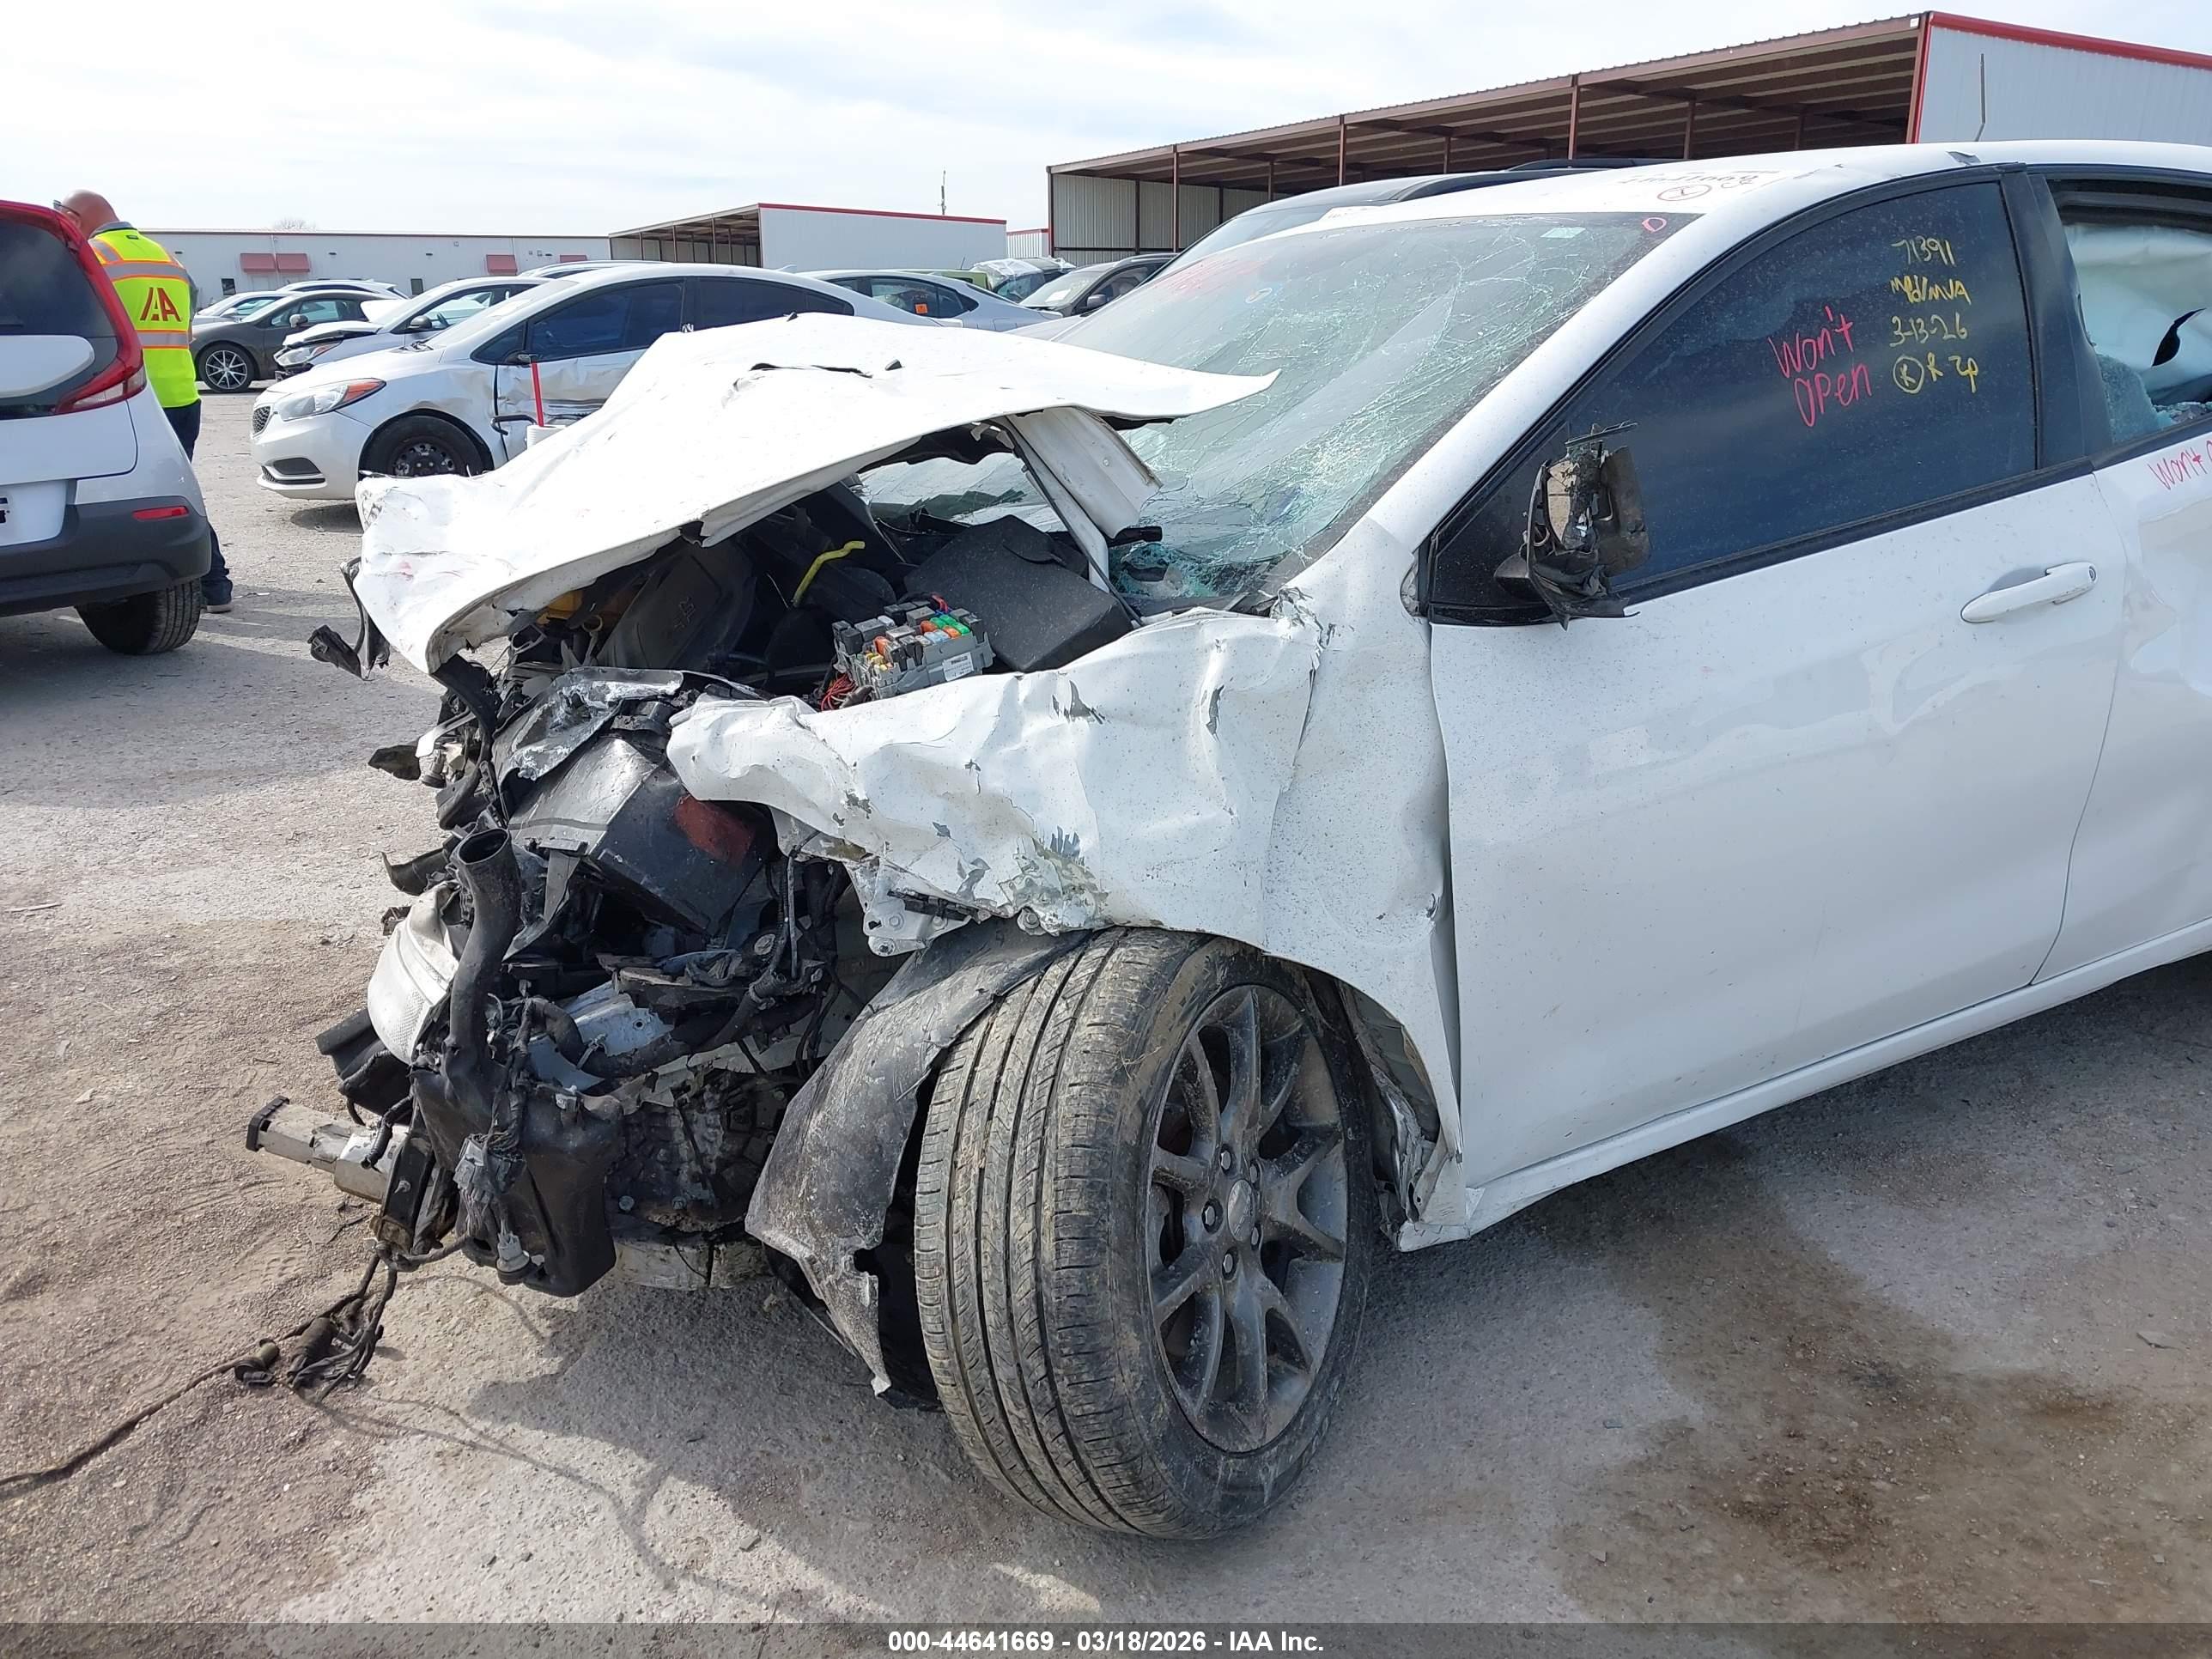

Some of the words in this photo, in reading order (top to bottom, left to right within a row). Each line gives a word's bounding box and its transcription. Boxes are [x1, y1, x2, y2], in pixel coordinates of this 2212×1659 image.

[1891, 235, 1956, 265] 71391
[1768, 306, 1854, 378] Won't
[1889, 312, 1967, 347] 3-13-26
